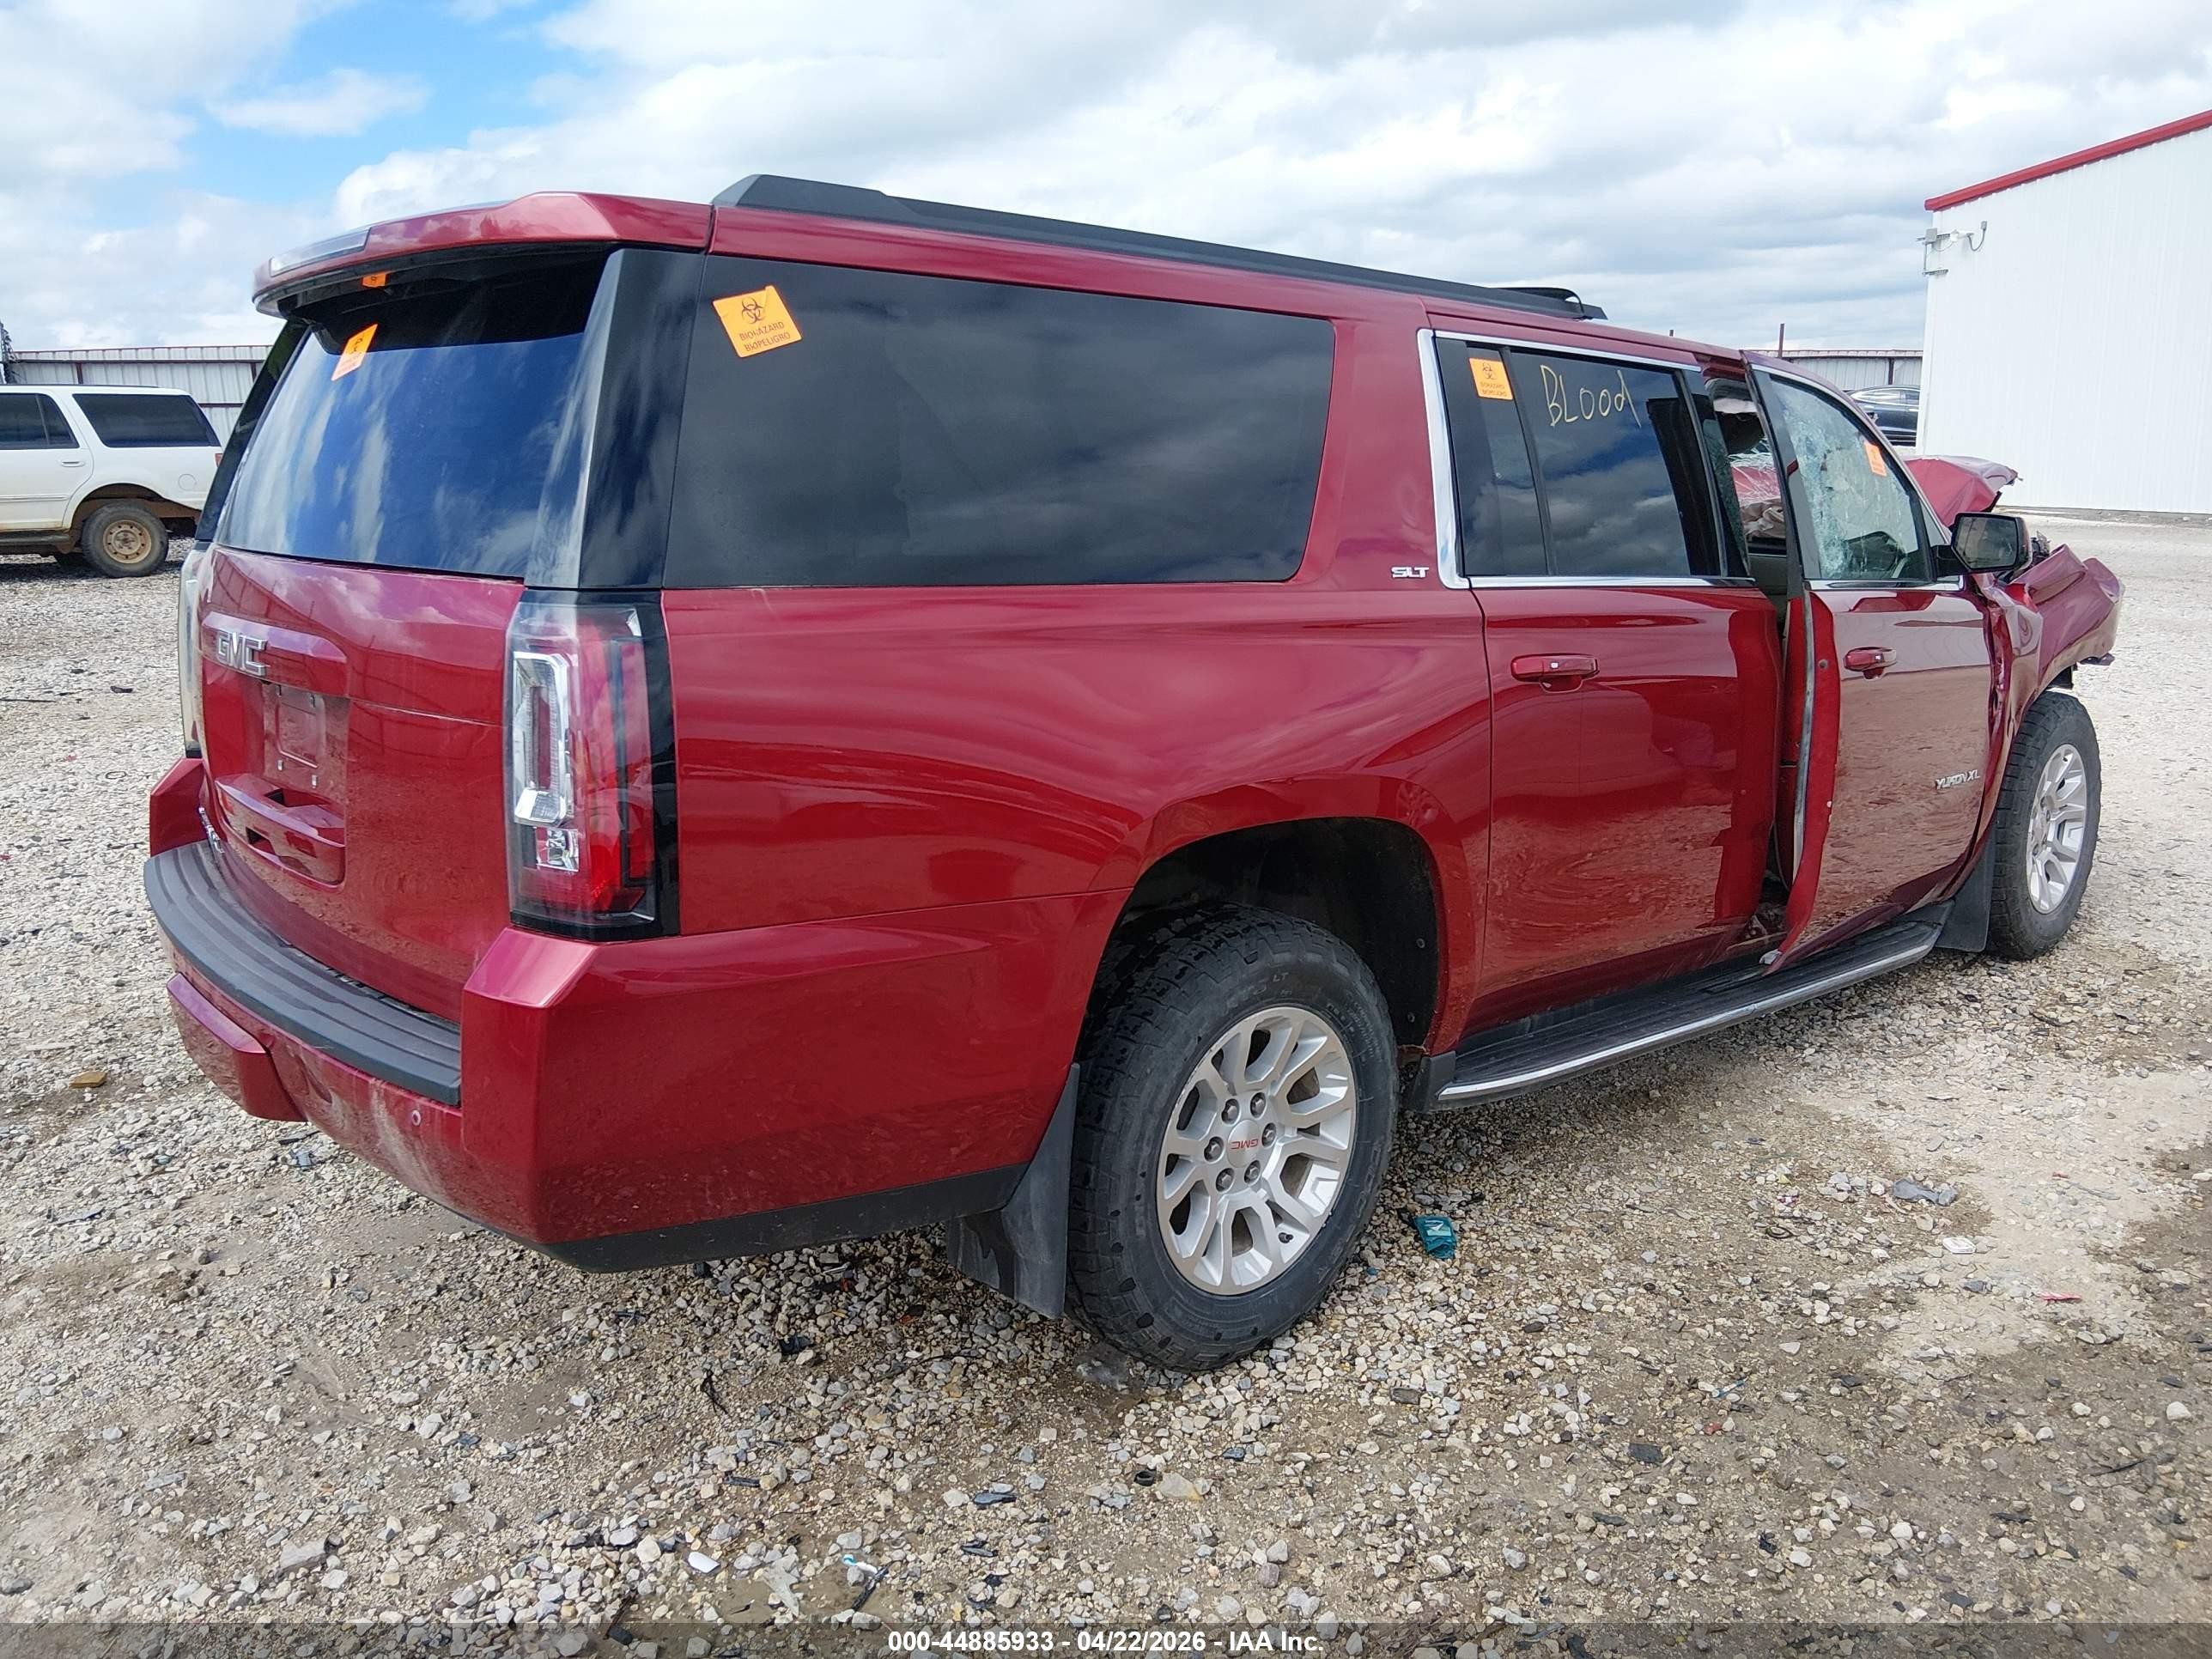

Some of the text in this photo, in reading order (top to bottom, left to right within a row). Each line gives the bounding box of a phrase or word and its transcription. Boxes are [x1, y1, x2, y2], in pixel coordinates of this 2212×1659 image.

[739, 321, 785, 341] BIOHAZARD
[744, 331, 791, 352] BIOPELIGRO
[1391, 566, 1430, 578] SLT
[216, 628, 268, 677] GMC
[1966, 769, 1980, 781] XL
[1230, 1139, 1259, 1150] GMC
